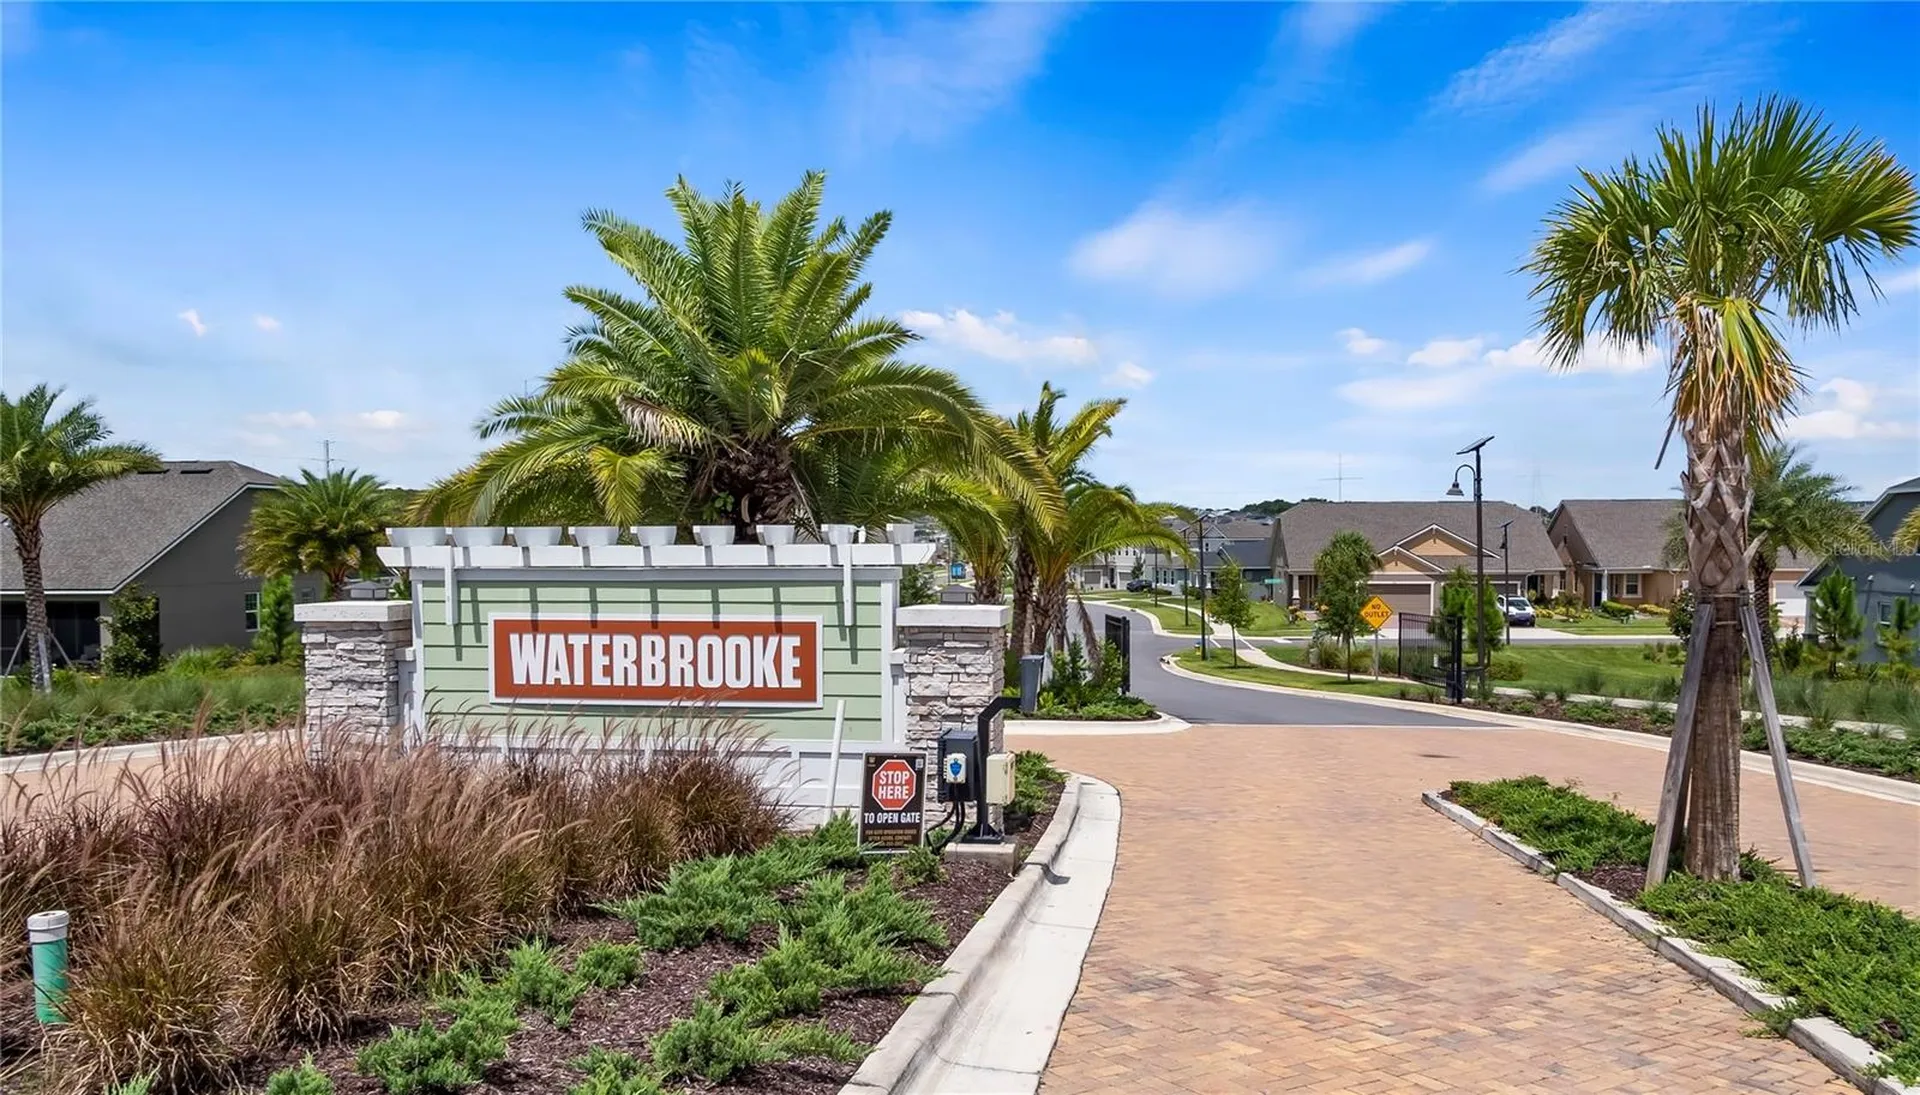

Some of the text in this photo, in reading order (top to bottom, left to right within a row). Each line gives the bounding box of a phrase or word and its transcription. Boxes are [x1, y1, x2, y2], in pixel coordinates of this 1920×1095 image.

[1363, 610, 1389, 618] OUTLET
[509, 632, 802, 689] WATERBROOKE
[879, 770, 910, 785] STOP
[878, 785, 909, 800] HERE
[864, 811, 921, 824] TO OPEN GATE
